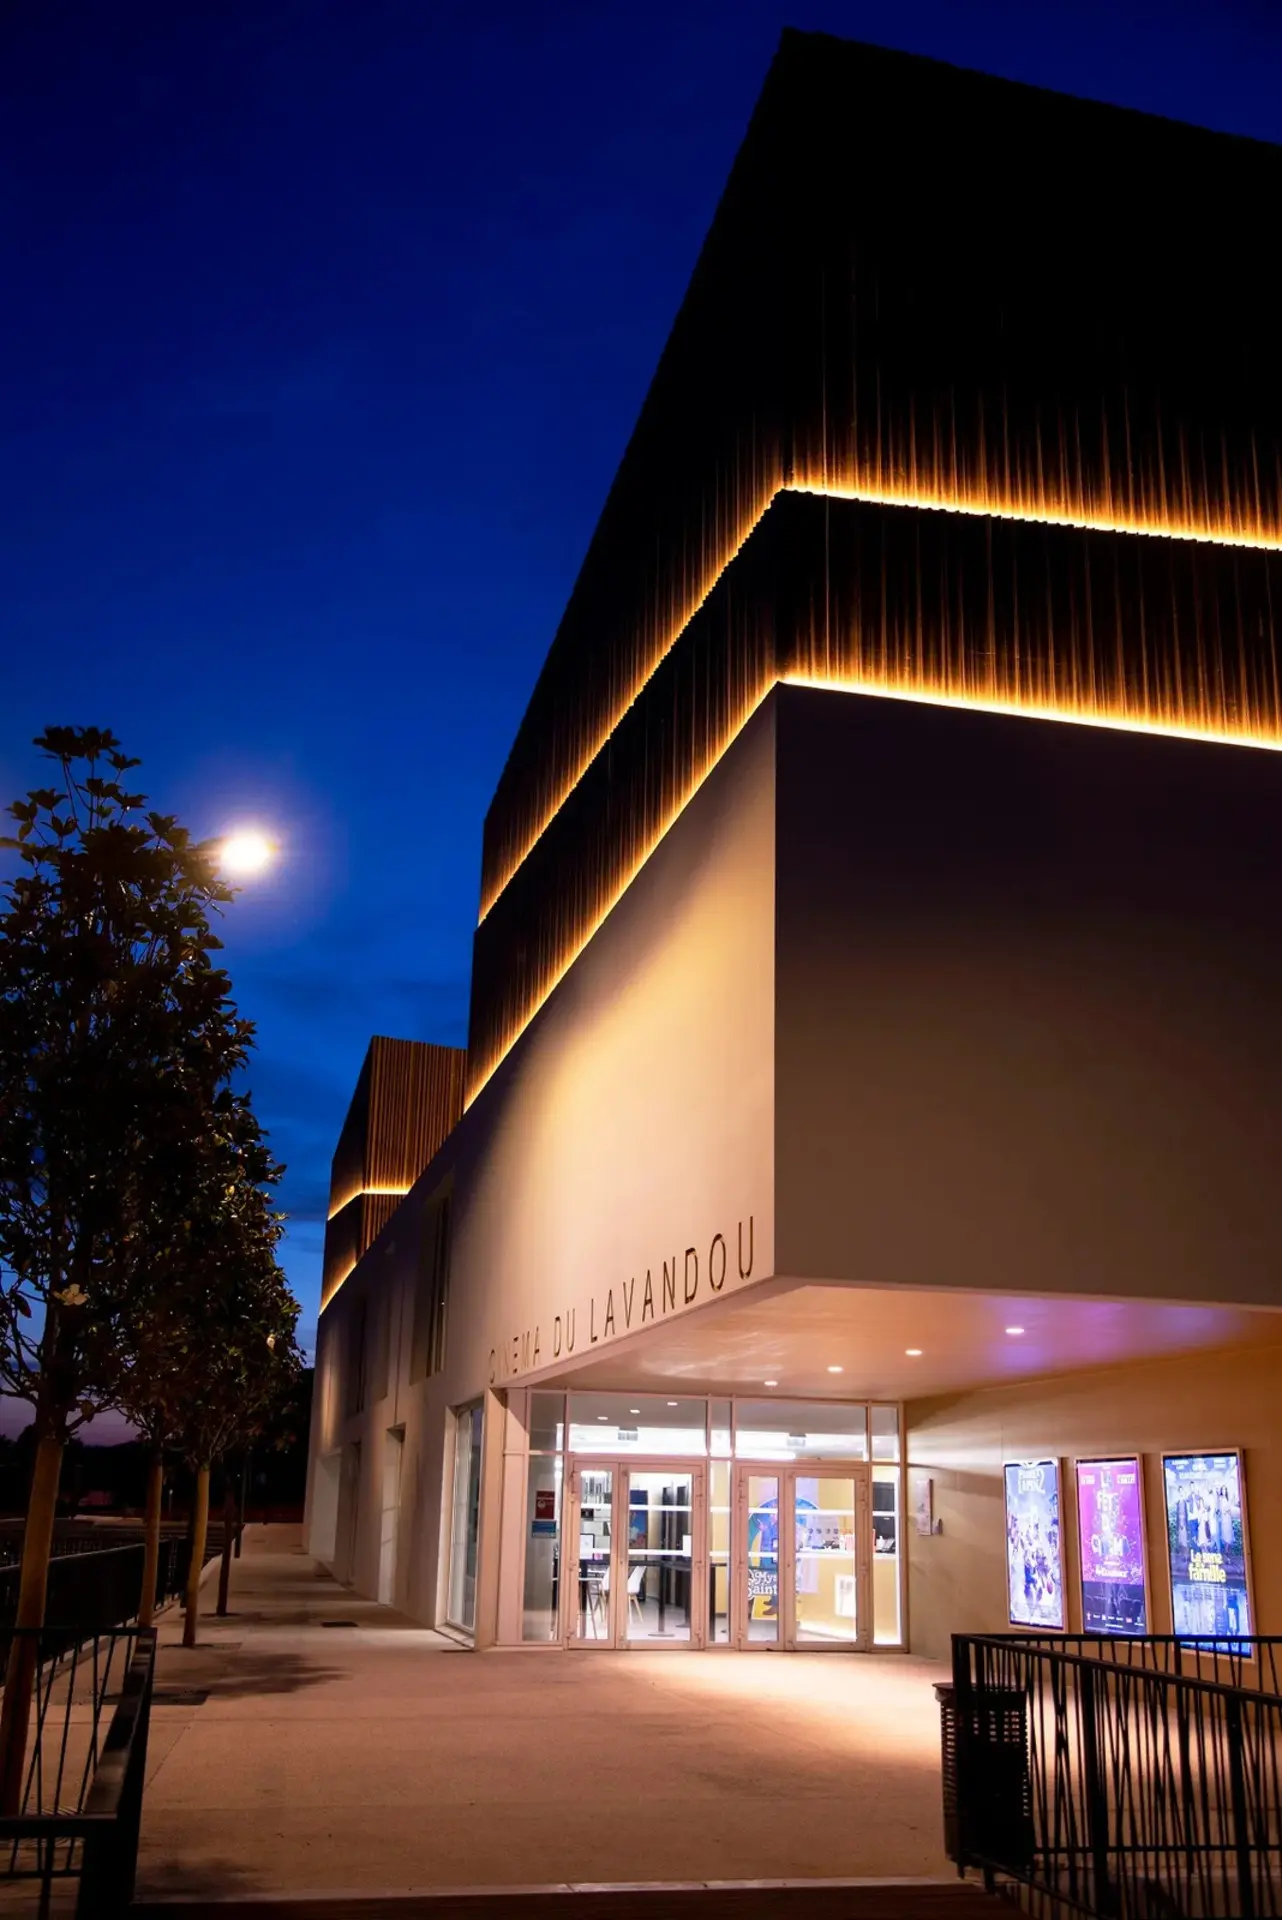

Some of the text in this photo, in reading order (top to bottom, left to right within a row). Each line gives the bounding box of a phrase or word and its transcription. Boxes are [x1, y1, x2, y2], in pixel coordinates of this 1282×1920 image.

[553, 1307, 576, 1358] DU
[589, 1215, 754, 1344] LAVANDOU
[1188, 1562, 1227, 1583] famille
